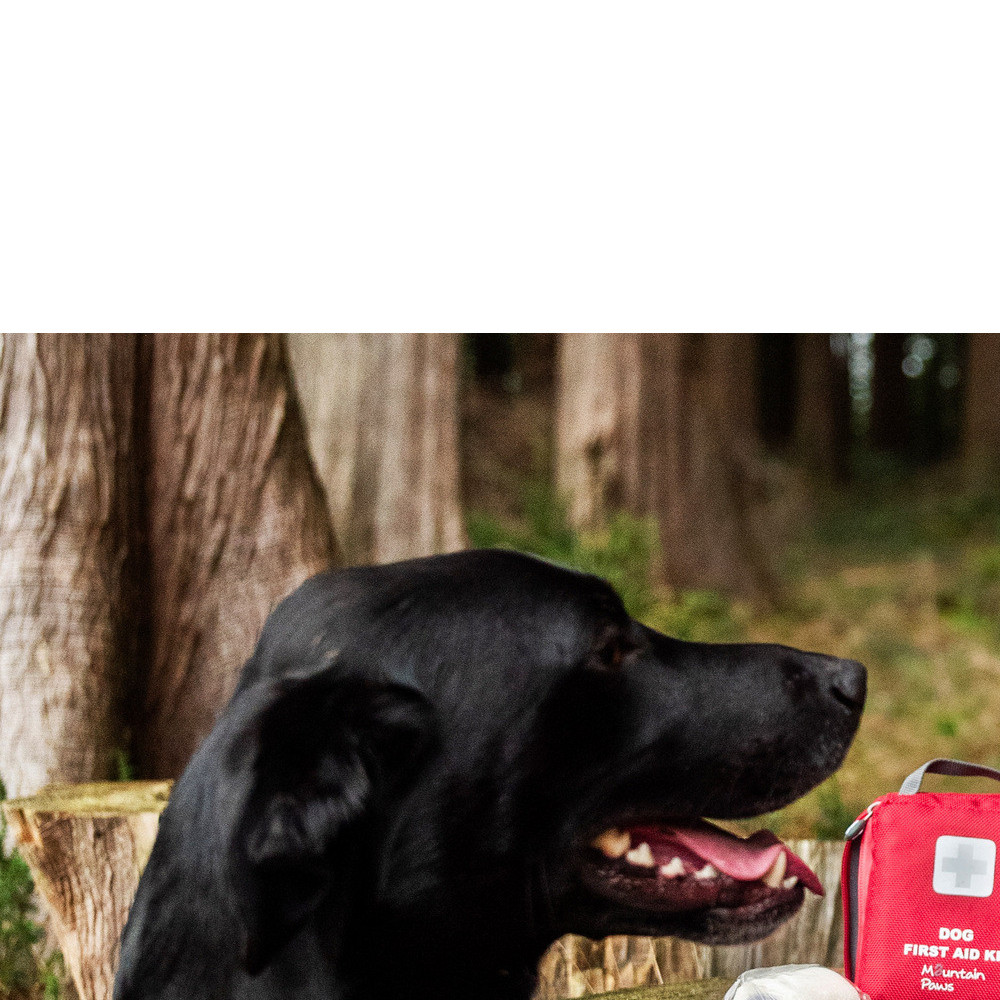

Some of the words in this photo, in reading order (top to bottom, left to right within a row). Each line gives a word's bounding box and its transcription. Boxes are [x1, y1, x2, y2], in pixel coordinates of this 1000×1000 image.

[938, 927, 975, 942] DOG
[903, 943, 950, 958] FIRST
[952, 947, 981, 960] AID
[921, 963, 986, 981] Mountain
[920, 977, 955, 992] Paws
